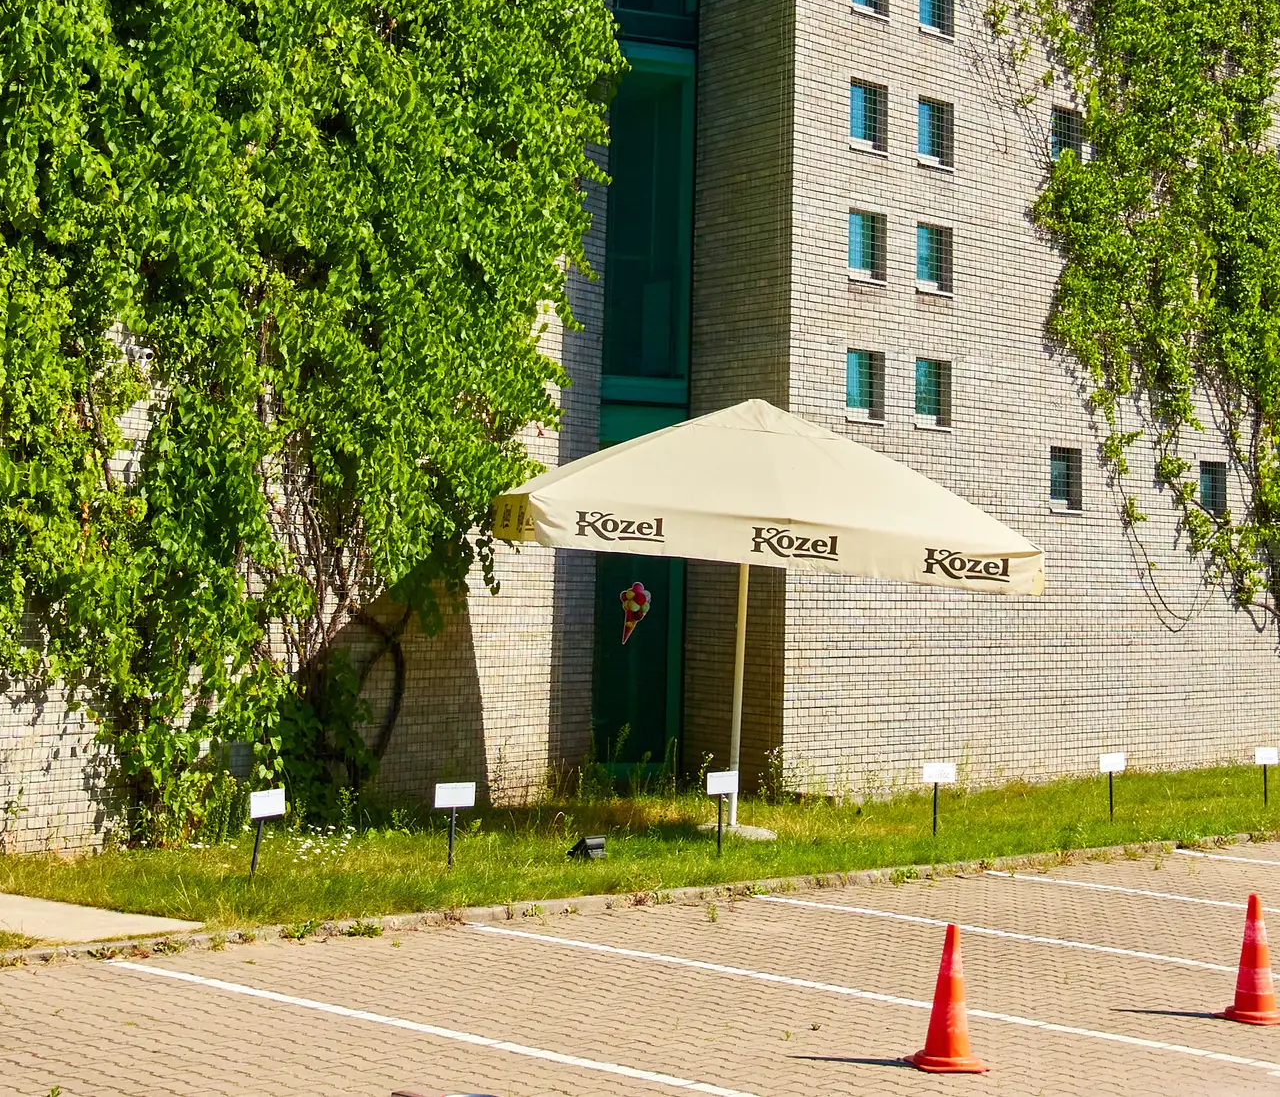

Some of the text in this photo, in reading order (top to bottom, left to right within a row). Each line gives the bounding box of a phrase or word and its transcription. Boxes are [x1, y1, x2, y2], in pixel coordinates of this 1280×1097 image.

[575, 510, 665, 542] Kozel
[750, 526, 839, 562] Kozel
[922, 547, 1010, 583] Kozel
